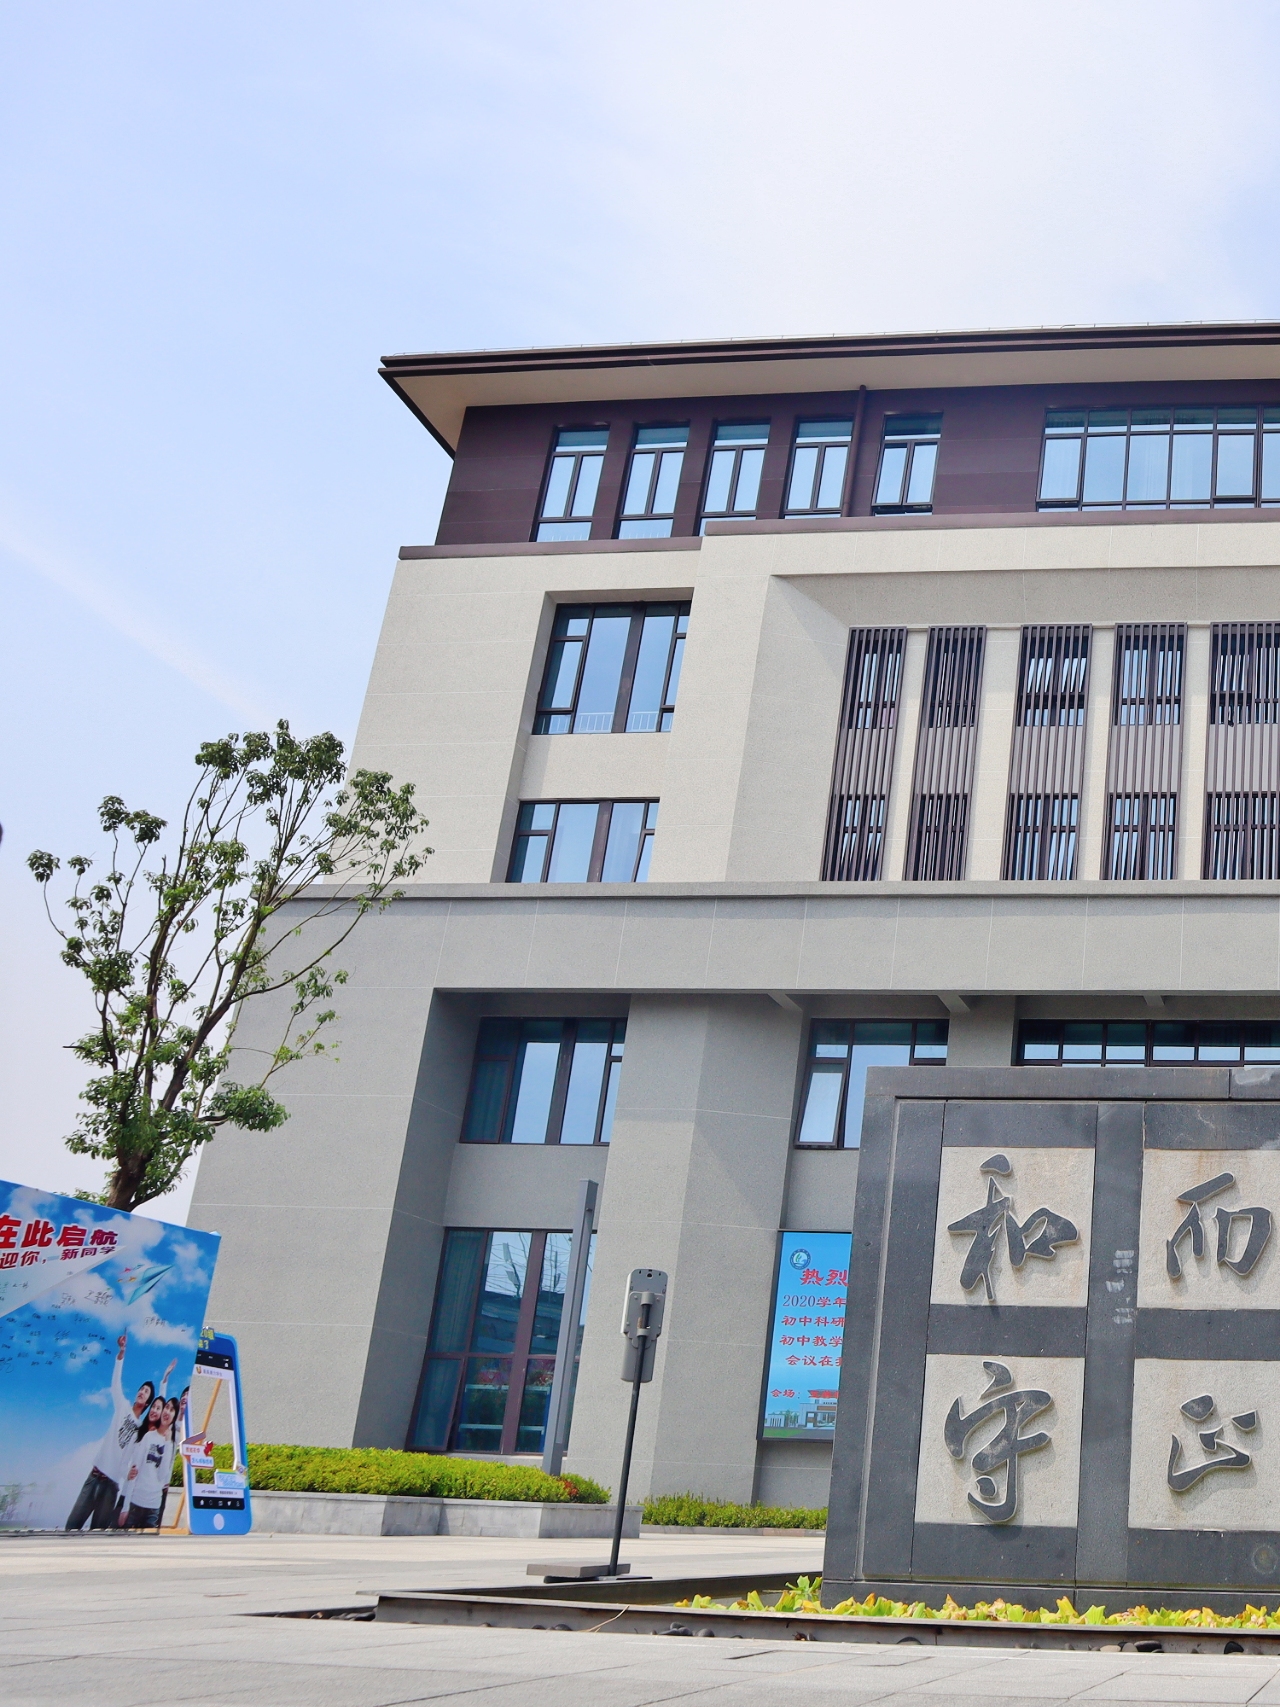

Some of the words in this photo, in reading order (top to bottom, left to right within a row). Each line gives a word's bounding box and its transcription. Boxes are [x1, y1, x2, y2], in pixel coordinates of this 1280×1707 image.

[0, 1213, 119, 1249] 在此启航
[800, 1268, 849, 1287] 热烈
[782, 1294, 847, 1309] 2020学年
[781, 1315, 846, 1328] 初中科研
[779, 1334, 843, 1347] 初中教学
